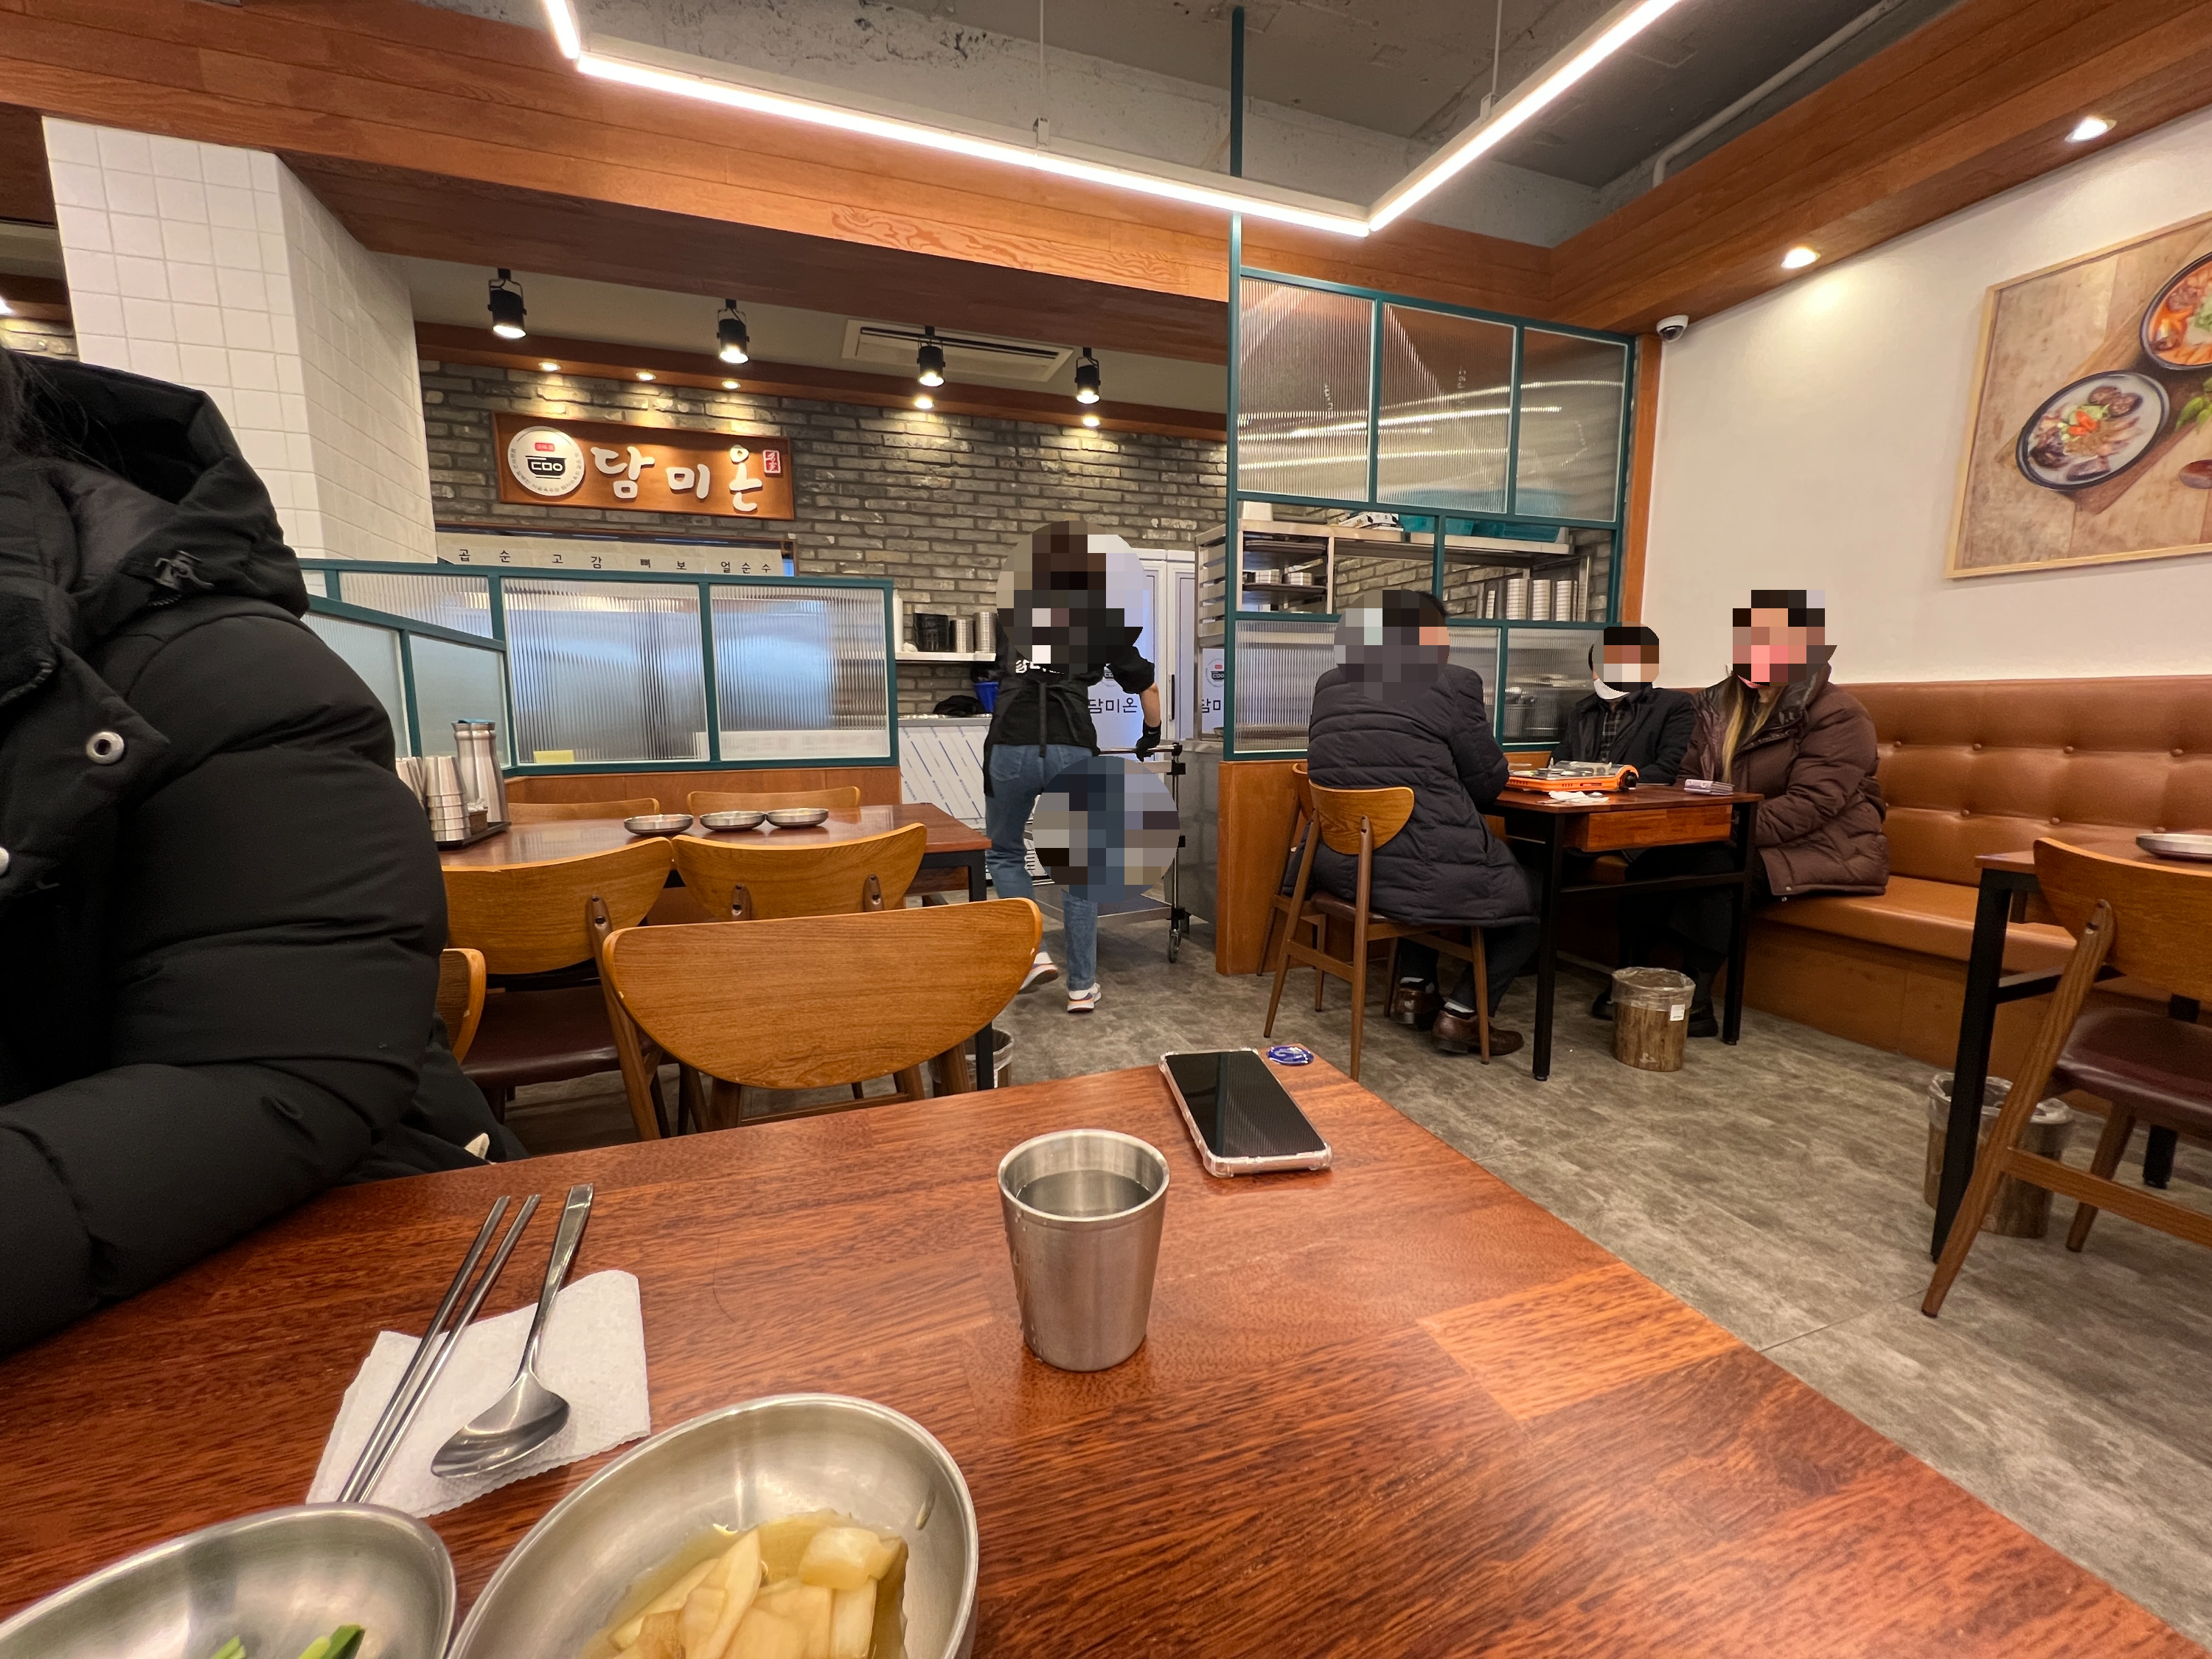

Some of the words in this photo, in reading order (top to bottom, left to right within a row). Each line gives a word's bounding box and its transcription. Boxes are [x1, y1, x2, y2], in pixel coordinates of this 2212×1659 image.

[591, 444, 763, 512] 담미온
[459, 549, 470, 562] 곱
[499, 549, 511, 563] 순
[552, 554, 563, 563] 고
[591, 556, 602, 569] 감
[676, 560, 687, 571] 보
[720, 561, 731, 574] 얼
[741, 562, 751, 574] 순
[761, 563, 771, 574] 수
[1088, 697, 1138, 714] 담미온
